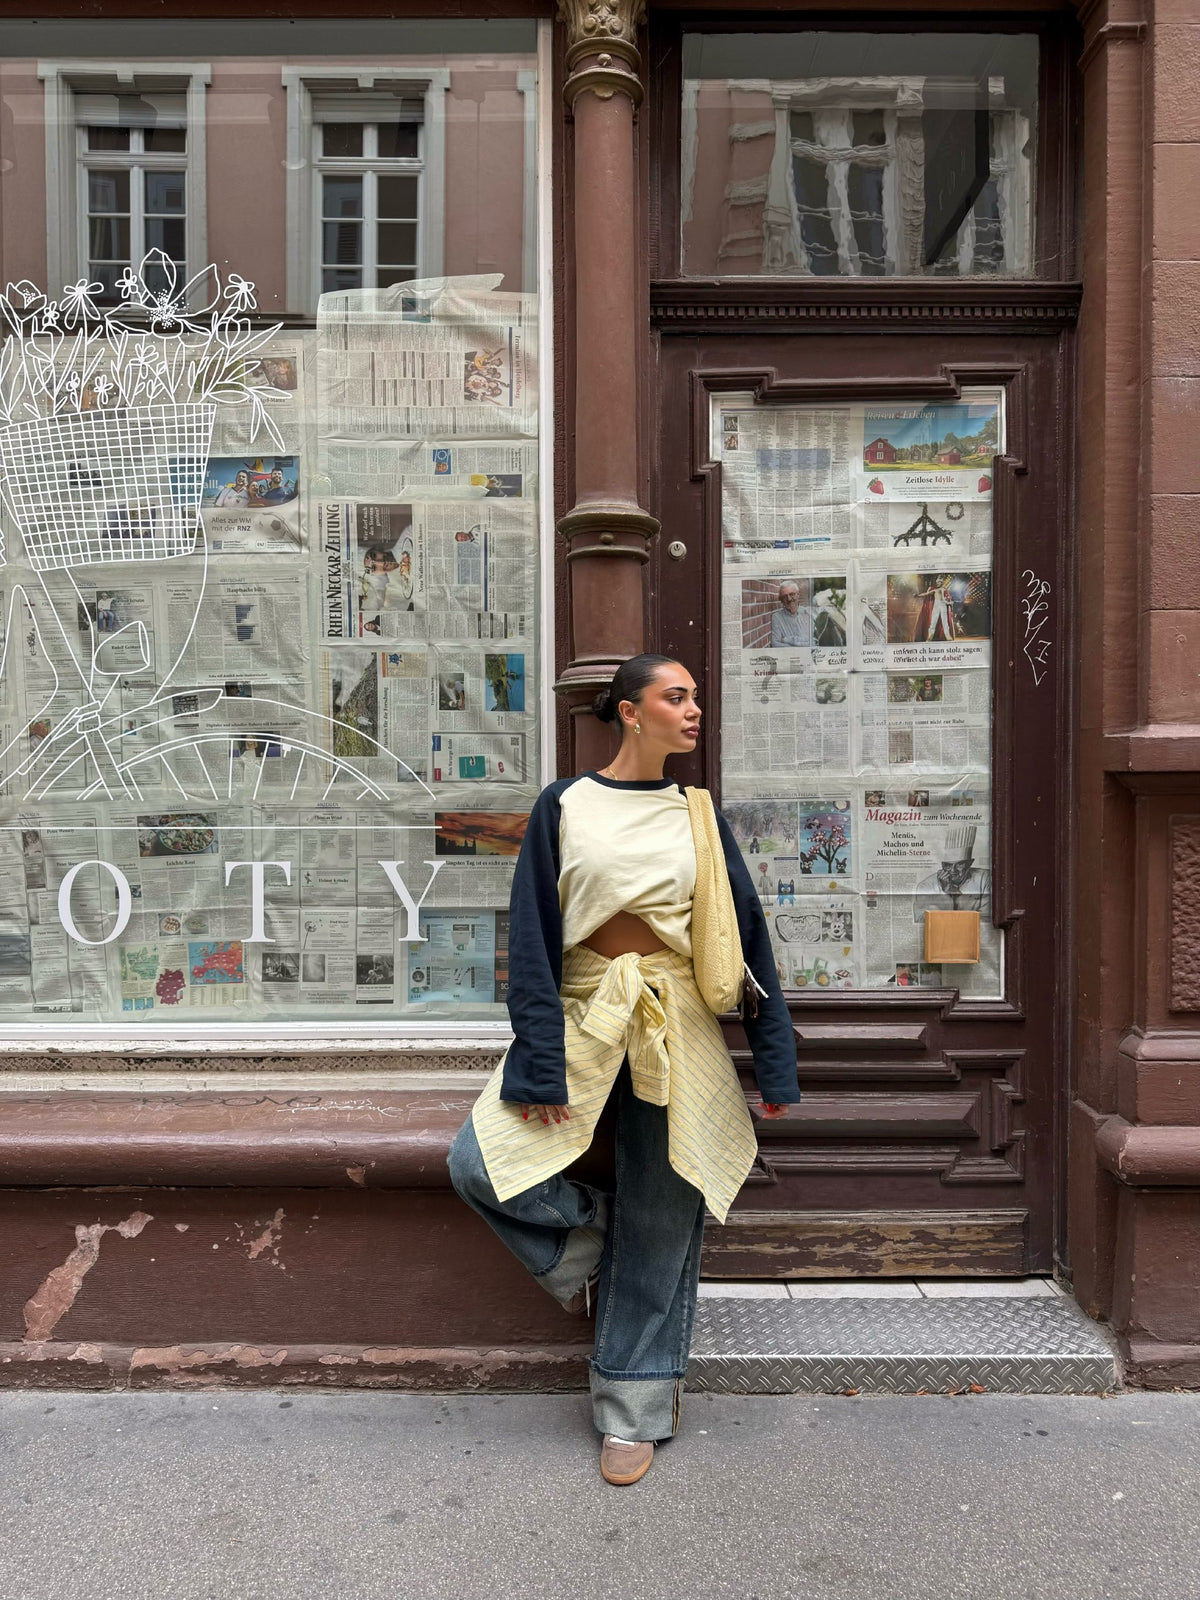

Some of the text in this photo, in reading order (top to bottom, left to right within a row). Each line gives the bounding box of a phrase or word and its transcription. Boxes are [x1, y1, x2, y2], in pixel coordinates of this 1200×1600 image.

[906, 476, 955, 484] Zeitlose Idylle
[866, 809, 921, 824] Magazin
